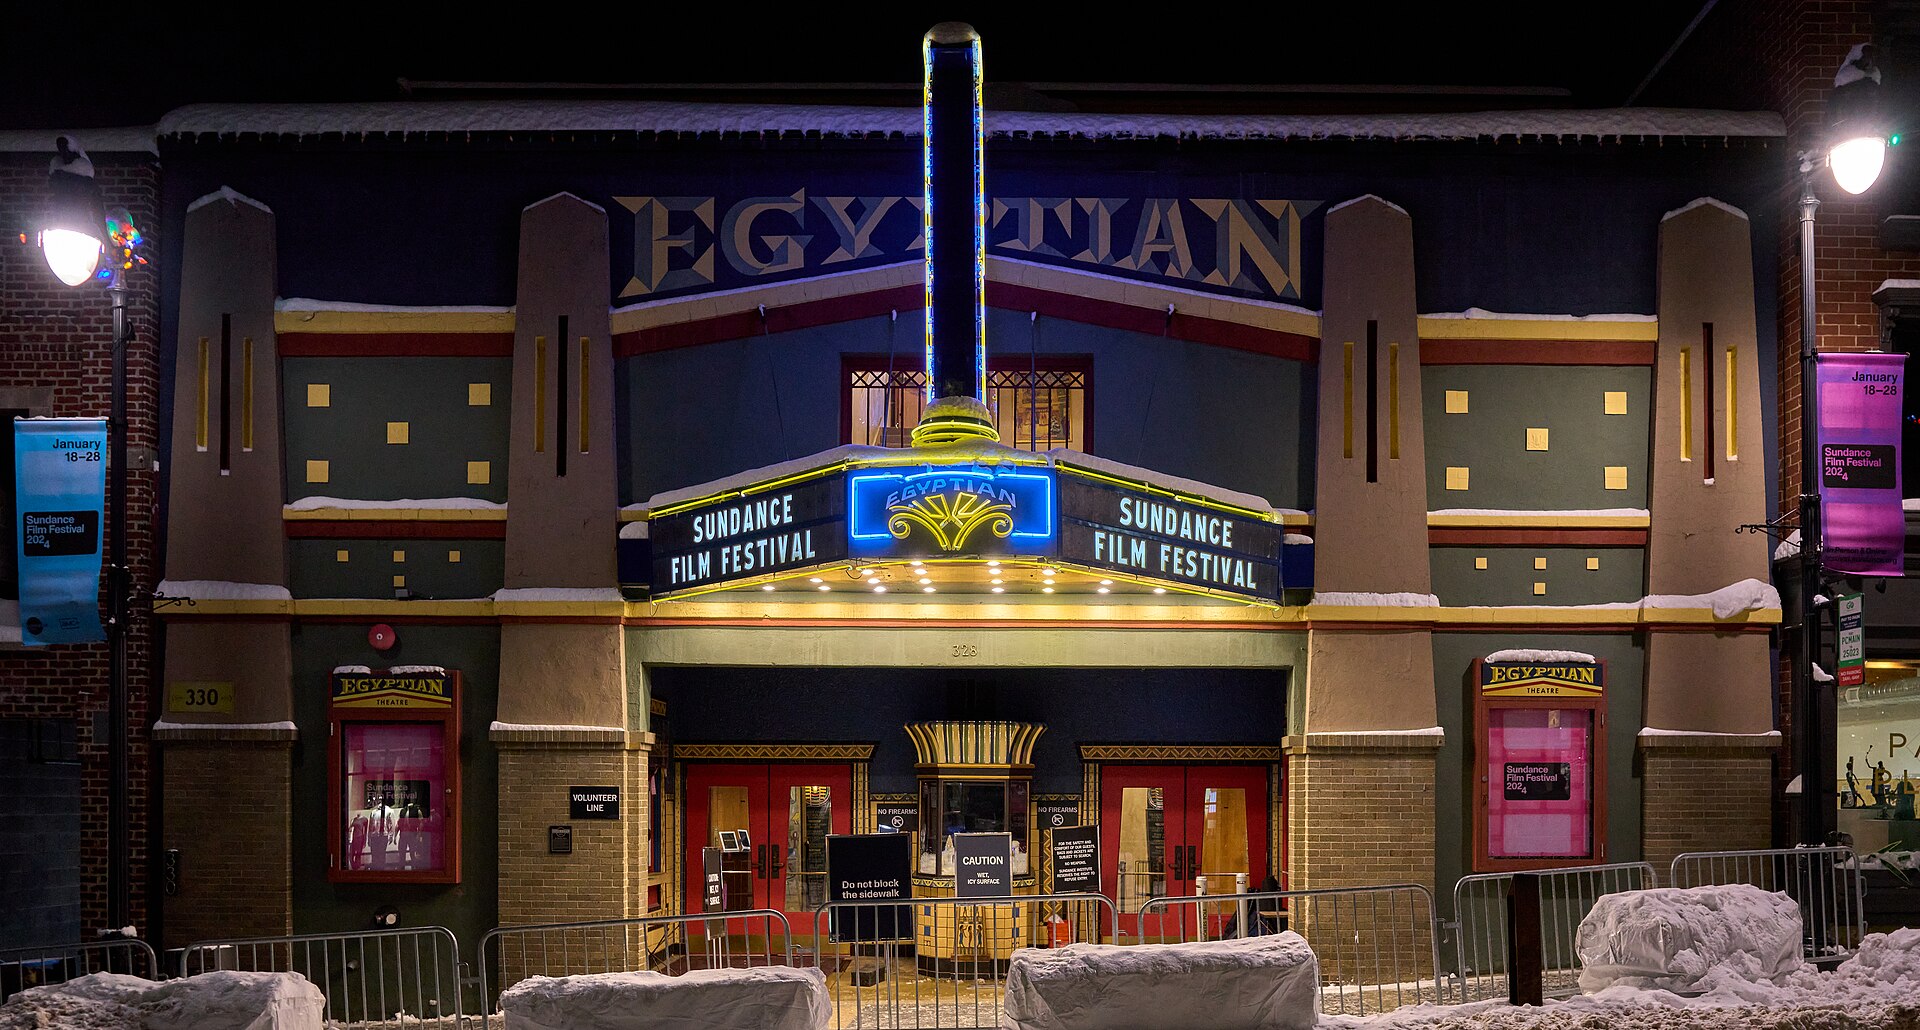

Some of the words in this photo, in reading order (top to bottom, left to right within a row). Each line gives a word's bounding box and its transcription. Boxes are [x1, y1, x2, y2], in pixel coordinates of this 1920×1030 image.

[611, 187, 1325, 300] EGYTIAN
[1852, 371, 1898, 384] January
[1864, 385, 1897, 396] 18–28
[53, 438, 101, 450] January
[65, 451, 101, 462] 18–28
[1825, 447, 1872, 457] Sundance
[1825, 457, 1845, 467] Film
[1847, 458, 1882, 467] Festival
[1825, 467, 1849, 481] 2024
[886, 478, 1017, 510] EGYPTIAN
[26, 515, 75, 525] Sundance
[693, 494, 793, 543] SUNDANCE
[1119, 497, 1233, 549] SUNDANCE
[26, 525, 47, 534] Film
[49, 523, 85, 534] Festival
[26, 535, 50, 549] 2024
[671, 550, 711, 584] FILM
[721, 529, 816, 575] FESTIVAL
[1095, 531, 1146, 569] FILM
[1160, 543, 1257, 589] FESTIVAL
[1842, 634, 1861, 645] PCMAIN
[952, 644, 978, 657] 328
[1490, 666, 1597, 684] EGYPTIAN
[340, 678, 444, 695] EGYPTIAN
[186, 688, 219, 706] 330
[1507, 765, 1549, 774] Sundance
[1507, 774, 1525, 782] Film
[1526, 774, 1558, 782] Festival
[367, 783, 409, 791] Sundance
[1507, 782, 1527, 794] 2024
[386, 791, 418, 799] Festival
[573, 794, 618, 802] VOLUNTEER
[587, 804, 604, 812] LINE
[963, 856, 1004, 865] CAUTION
[842, 880, 856, 889] Do
[857, 880, 873, 889] not
[874, 878, 900, 888] block
[842, 890, 858, 899] the
[859, 888, 900, 899] sidewalk
